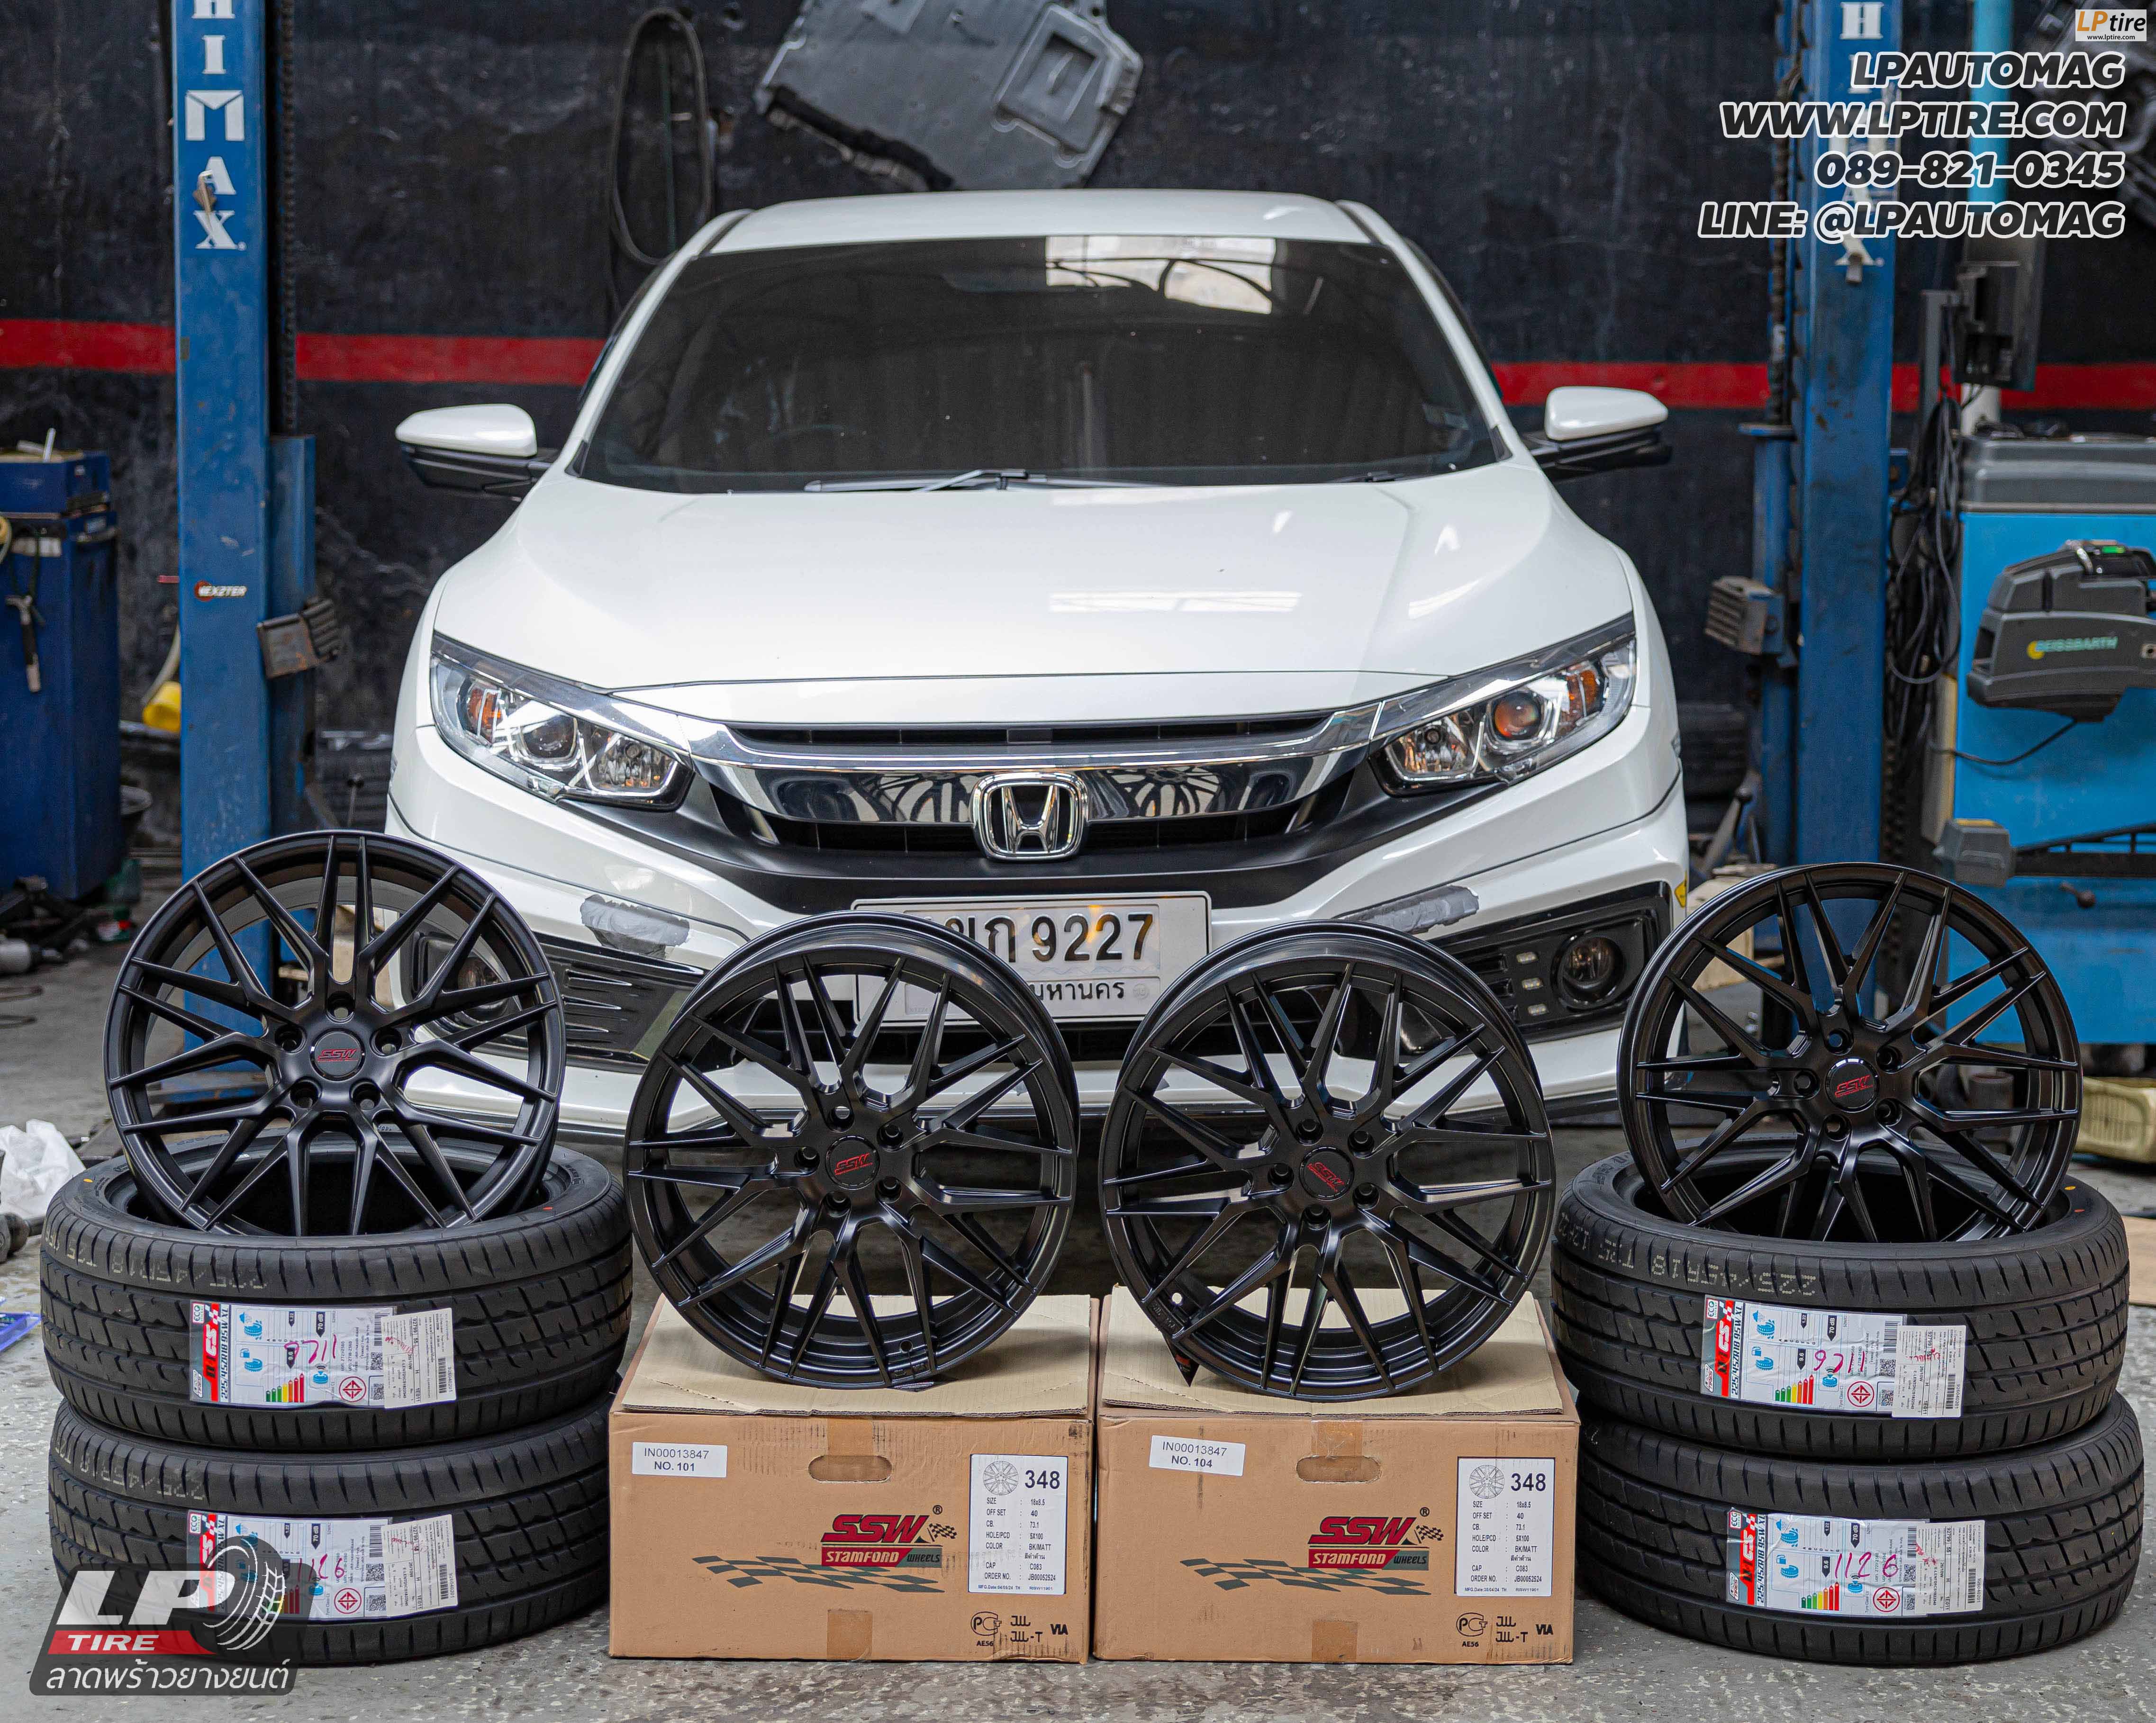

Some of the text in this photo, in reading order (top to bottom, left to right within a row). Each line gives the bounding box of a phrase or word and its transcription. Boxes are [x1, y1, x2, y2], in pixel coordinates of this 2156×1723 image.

[1031, 913, 1153, 962] 9227
[221, 1308, 228, 1317] XL
[317, 1314, 323, 1322] dB
[1732, 1342, 1740, 1395] 225/45ZR18
[1736, 1306, 1742, 1316] XL
[644, 1448, 709, 1459] IN00013847
[1162, 1441, 1227, 1456] IN00013847
[654, 1461, 694, 1471] NO. 101
[1171, 1455, 1213, 1468] NO. 104
[1024, 1470, 1060, 1489] 348
[1511, 1472, 1546, 1492] 348
[313, 1525, 318, 1534] dB
[821, 1514, 930, 1543] SSW
[1308, 1516, 1417, 1545] SSW
[1852, 1525, 1857, 1533] dB
[1834, 1552, 1898, 1579] 1126
[1050, 1624, 1069, 1635] VIA
[1535, 1624, 1554, 1635] VIA
